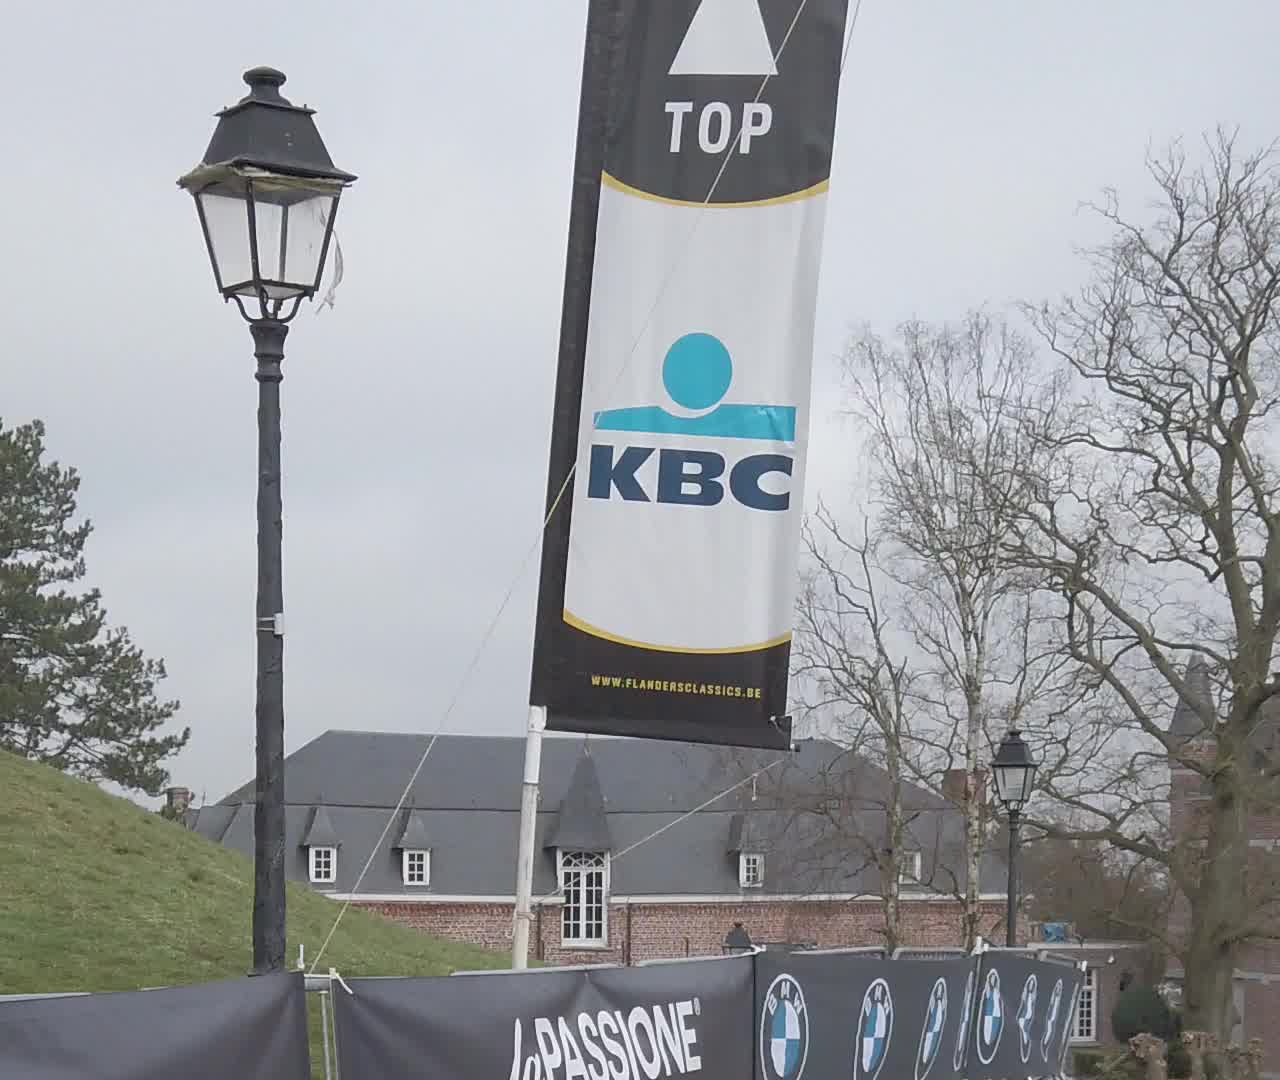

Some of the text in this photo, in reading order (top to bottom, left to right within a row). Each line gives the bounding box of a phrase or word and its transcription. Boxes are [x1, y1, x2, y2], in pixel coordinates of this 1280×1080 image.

[664, 101, 773, 154] TOP
[587, 444, 794, 512] KBC
[591, 674, 762, 699] WWW.FLANDERSCLASSICS.BE
